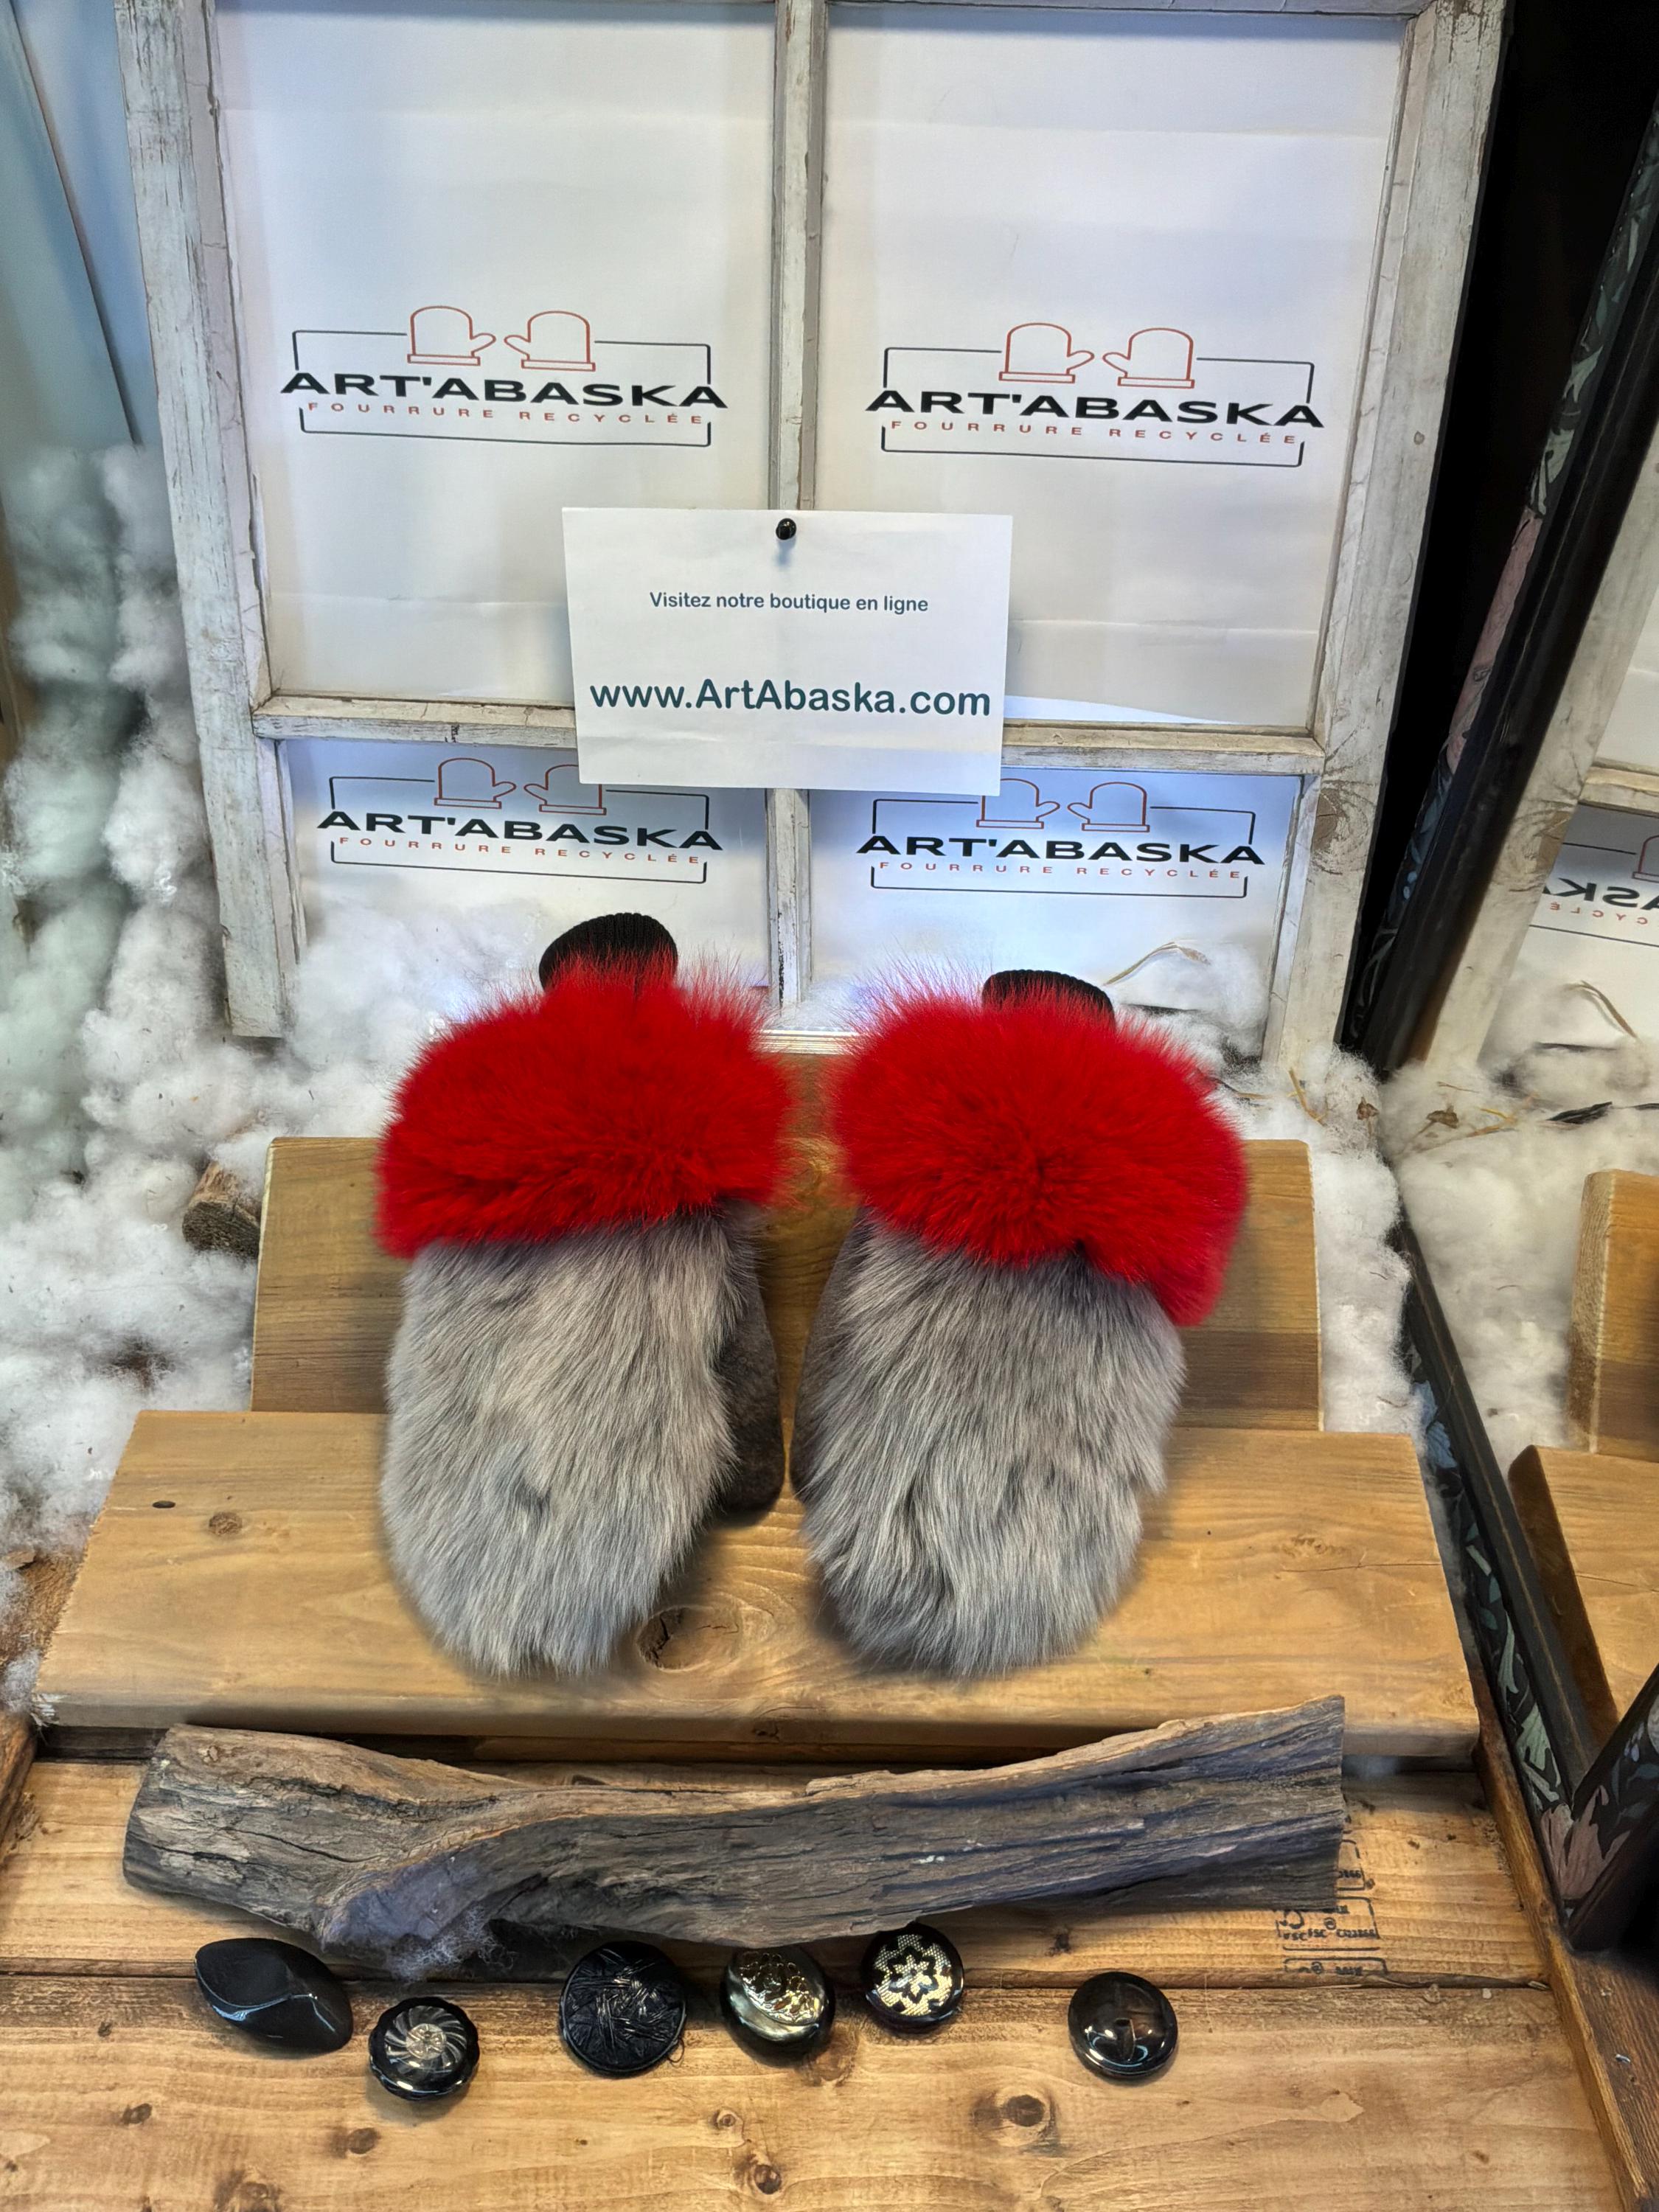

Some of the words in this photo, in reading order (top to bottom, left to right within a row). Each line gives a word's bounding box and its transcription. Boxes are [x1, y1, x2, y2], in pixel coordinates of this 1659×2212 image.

[281, 372, 728, 409] ART'ABASKA
[308, 403, 493, 418] FOURRURE
[519, 411, 701, 425] RECYCLÉE
[866, 390, 1324, 428] ART'ABASKA
[890, 420, 1082, 436] FOURRURE
[1109, 428, 1295, 444] RECYCLÉE
[650, 591, 712, 608] Visitez
[716, 593, 765, 608] notre
[770, 593, 851, 613] boutique
[856, 599, 878, 611] en
[884, 595, 928, 615] ligne
[590, 678, 990, 716] www.ArtAbaska.com
[317, 811, 723, 851] ART'ABASKA
[339, 837, 511, 854] FOURRURE
[535, 848, 699, 864] RECYCLÉE
[857, 835, 1265, 866] ART'ABASKA
[880, 862, 1052, 874] FOURRURE
[1077, 868, 1239, 879] RECYCLÉE
